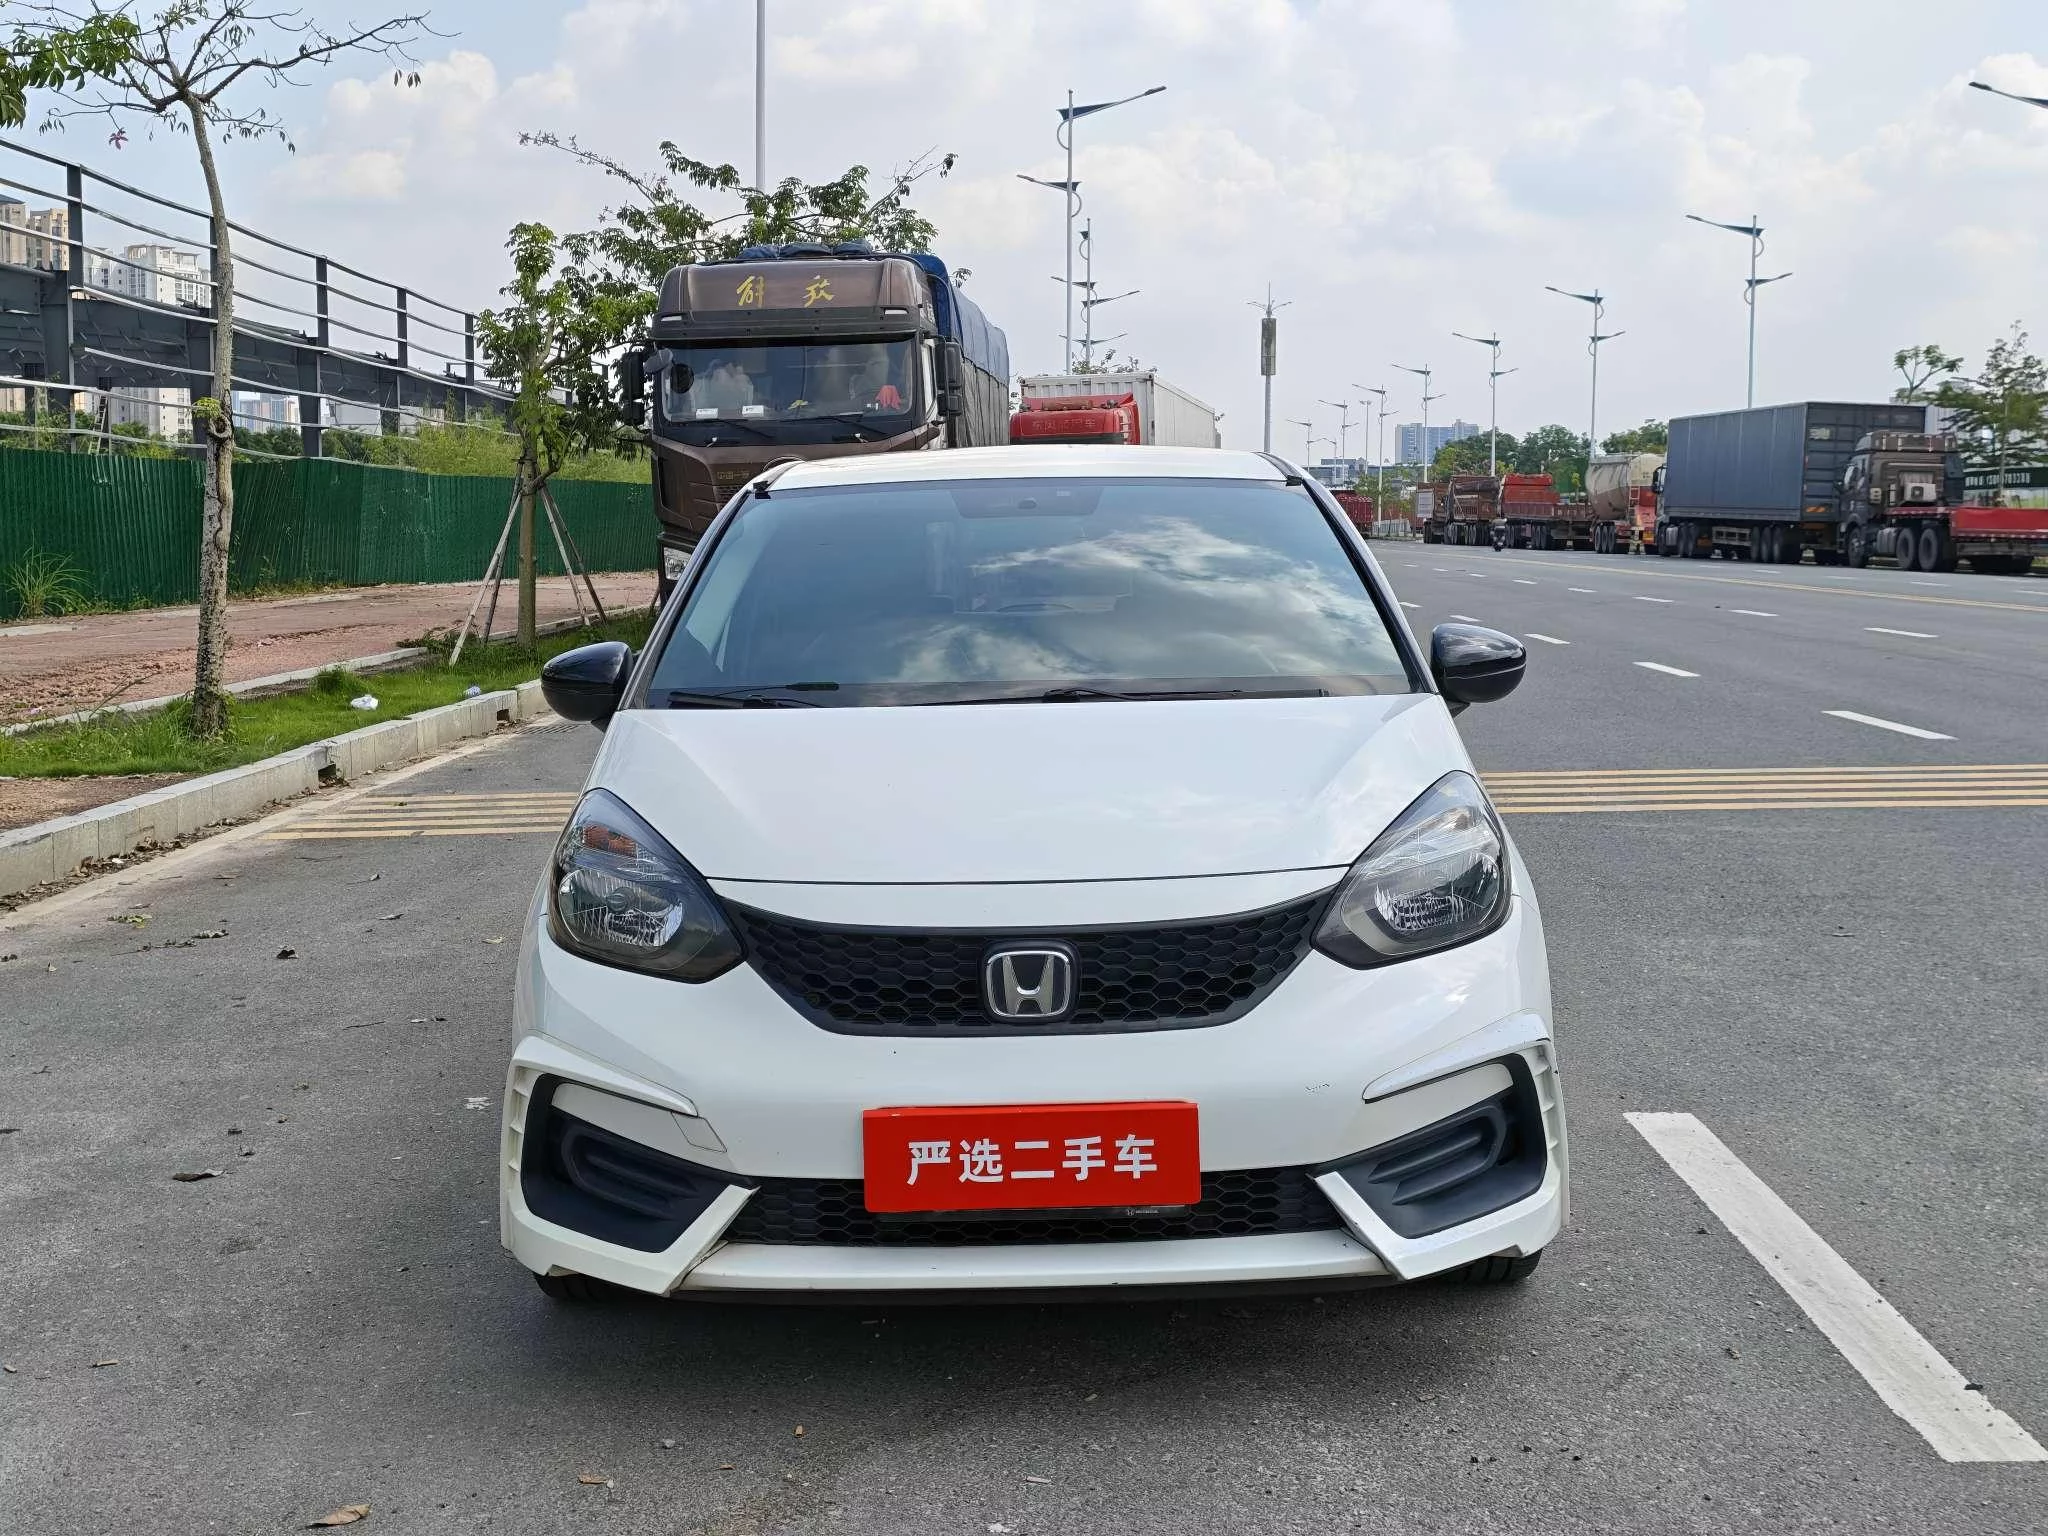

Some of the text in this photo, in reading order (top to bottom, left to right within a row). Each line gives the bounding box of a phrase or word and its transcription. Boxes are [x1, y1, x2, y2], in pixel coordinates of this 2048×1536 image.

[906, 1134, 1157, 1185] 严选二手车
